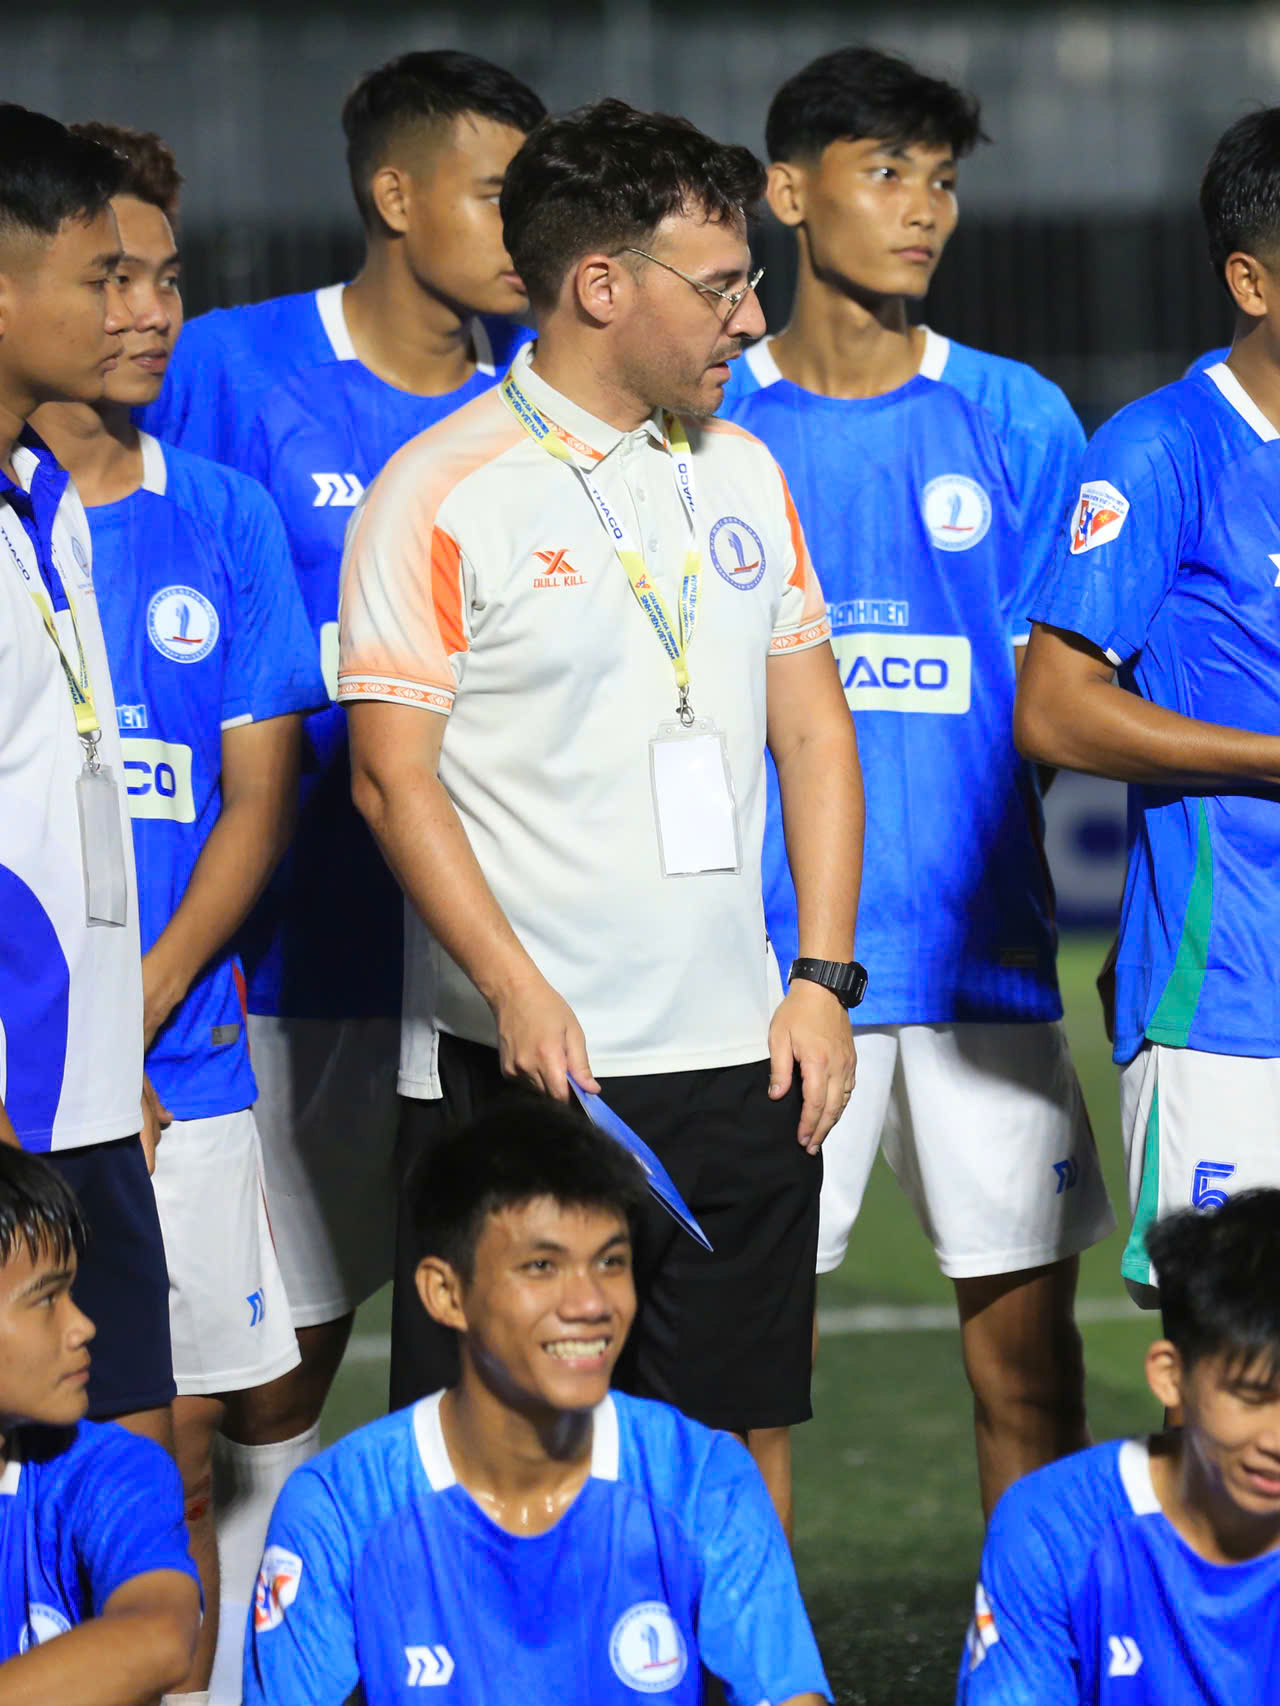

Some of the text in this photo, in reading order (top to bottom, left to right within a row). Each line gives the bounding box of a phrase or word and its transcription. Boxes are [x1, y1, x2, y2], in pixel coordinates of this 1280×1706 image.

[592, 489, 623, 540] THACO
[1, 526, 30, 581] THACO
[836, 656, 949, 691] ACO
[1191, 1160, 1237, 1210] 5
